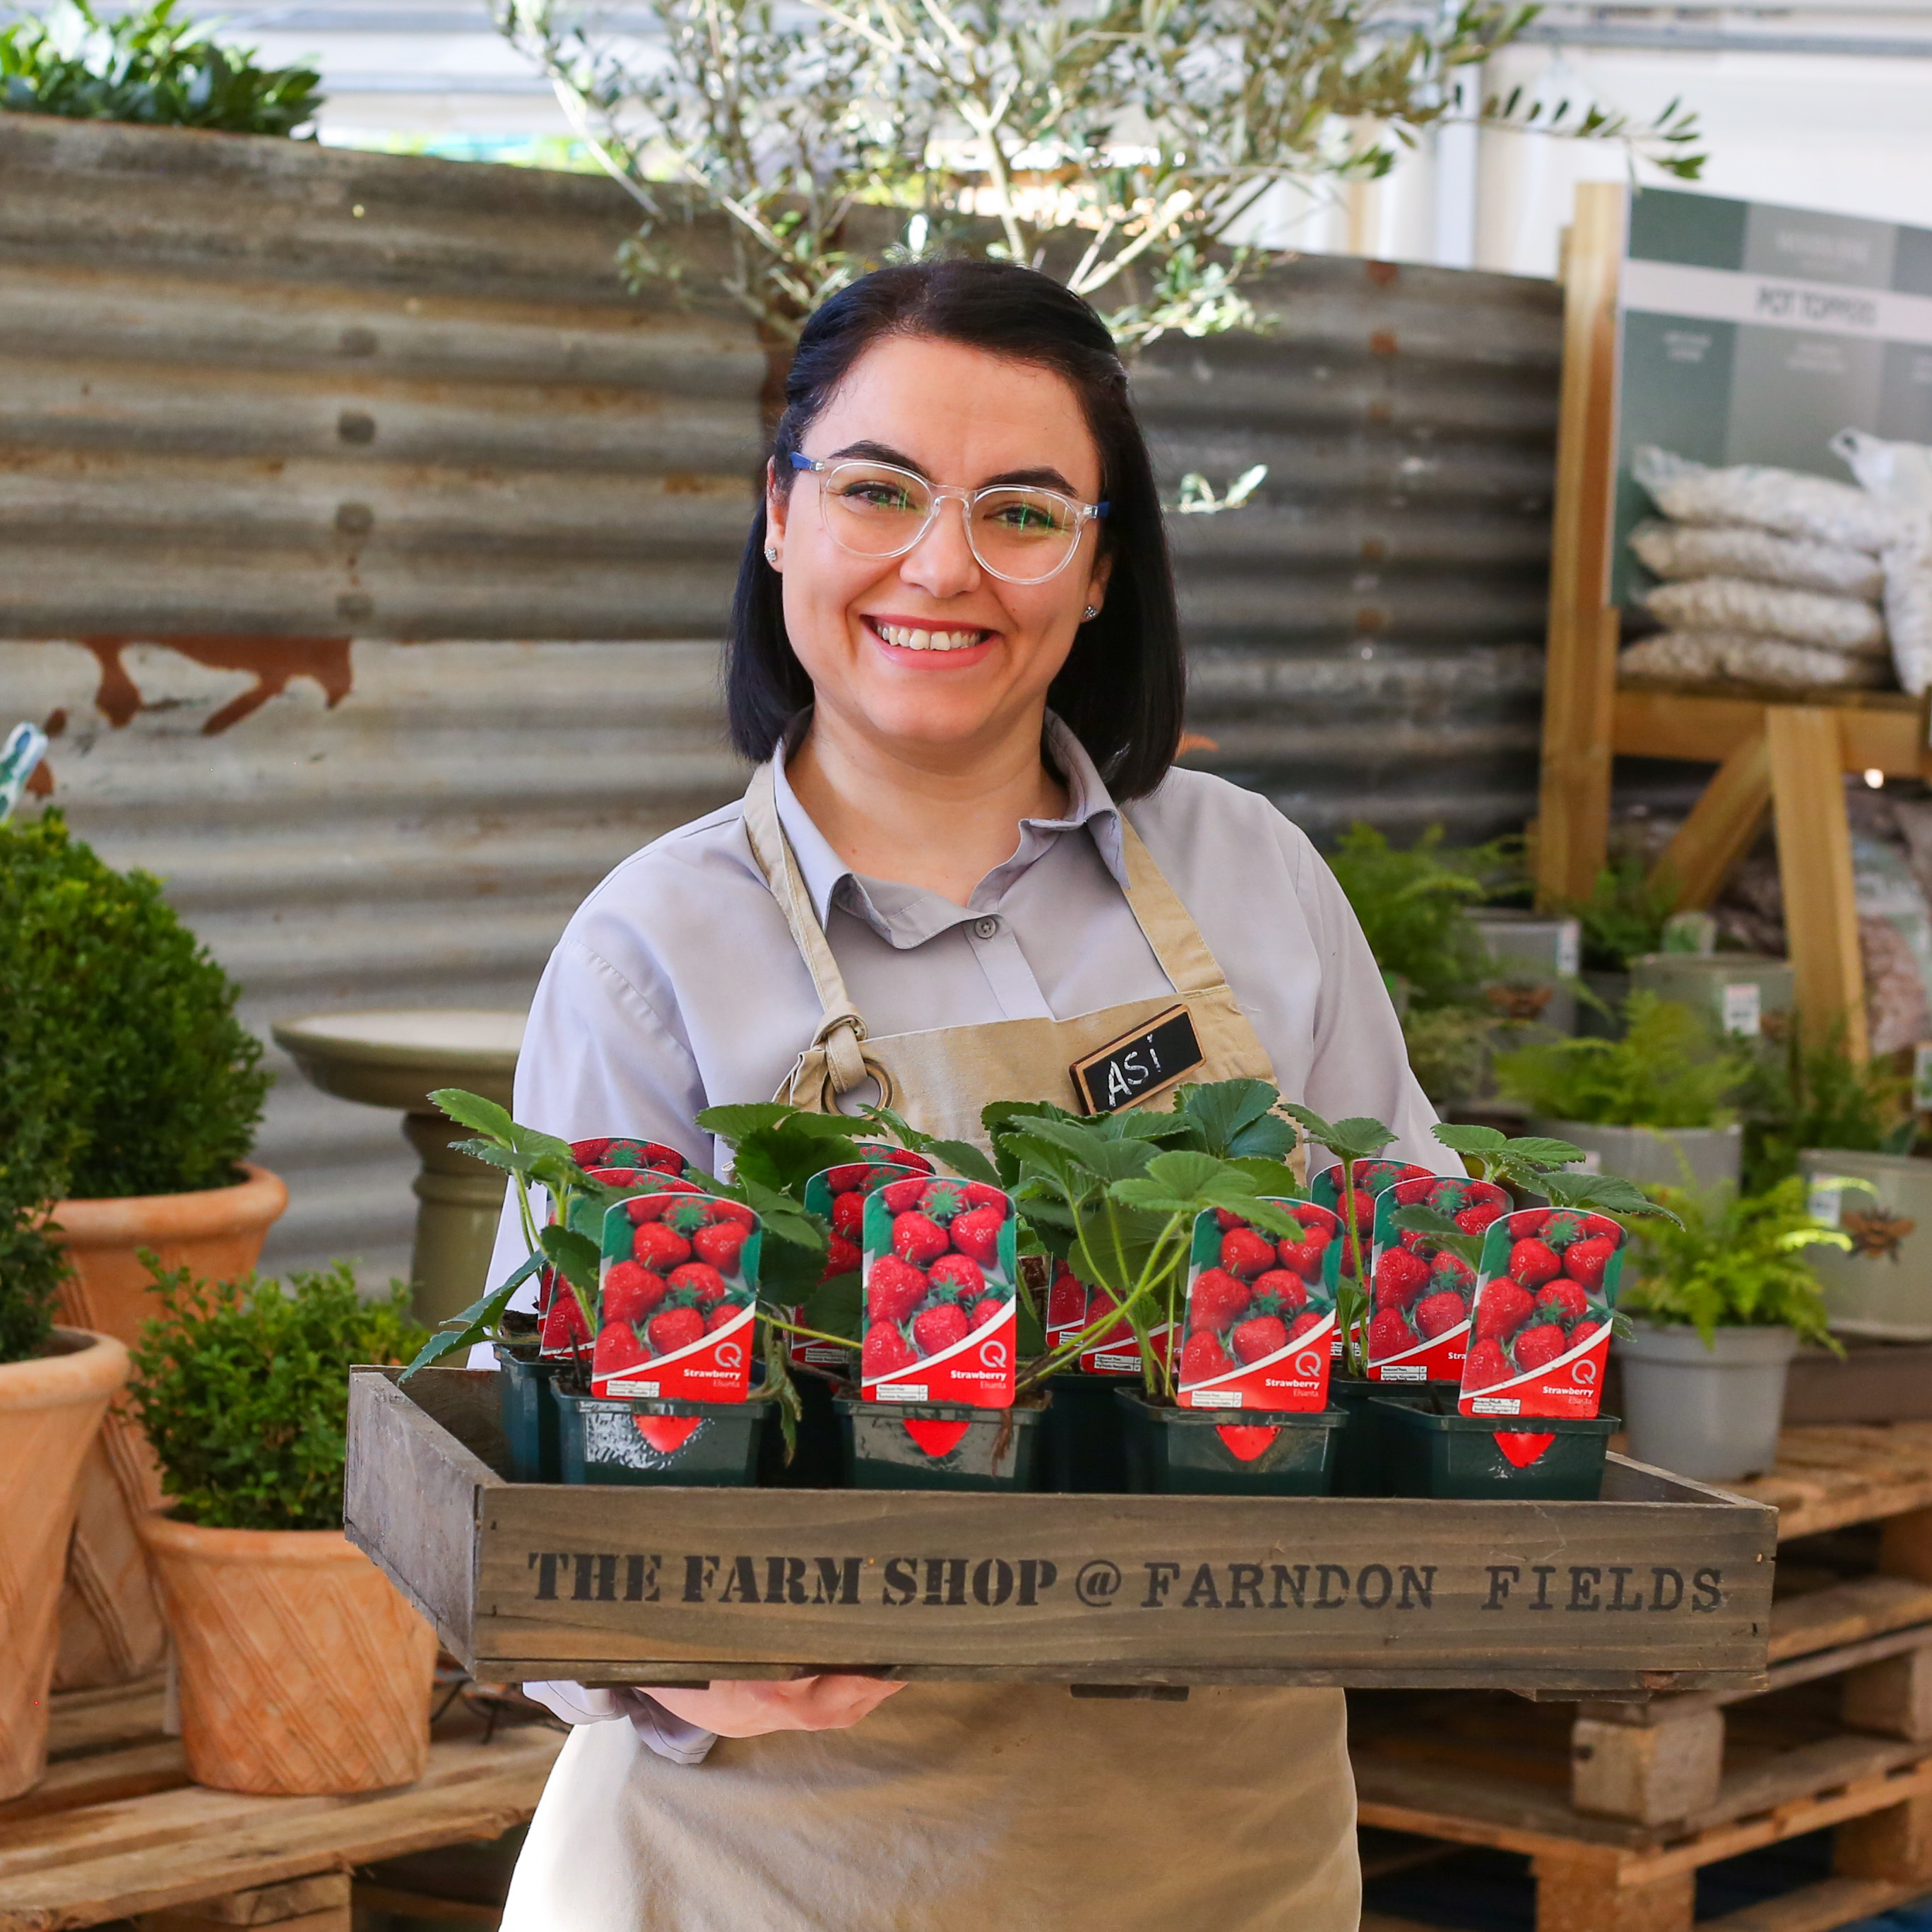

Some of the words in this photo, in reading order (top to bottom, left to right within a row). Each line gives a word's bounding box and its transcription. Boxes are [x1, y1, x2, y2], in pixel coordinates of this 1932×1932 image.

[683, 1368, 741, 1380] Strawberry
[950, 1370, 1007, 1382] Strawberry
[1265, 1378, 1320, 1389] Strawberry
[1542, 1386, 1594, 1397] Strawberry
[528, 1552, 662, 1601] THE
[682, 1555, 863, 1604] FARM
[882, 1558, 1058, 1606] SHOP
[1074, 1559, 1122, 1608] @
[1140, 1562, 1438, 1609] FARNDON
[1481, 1565, 1722, 1613] FIELDS
